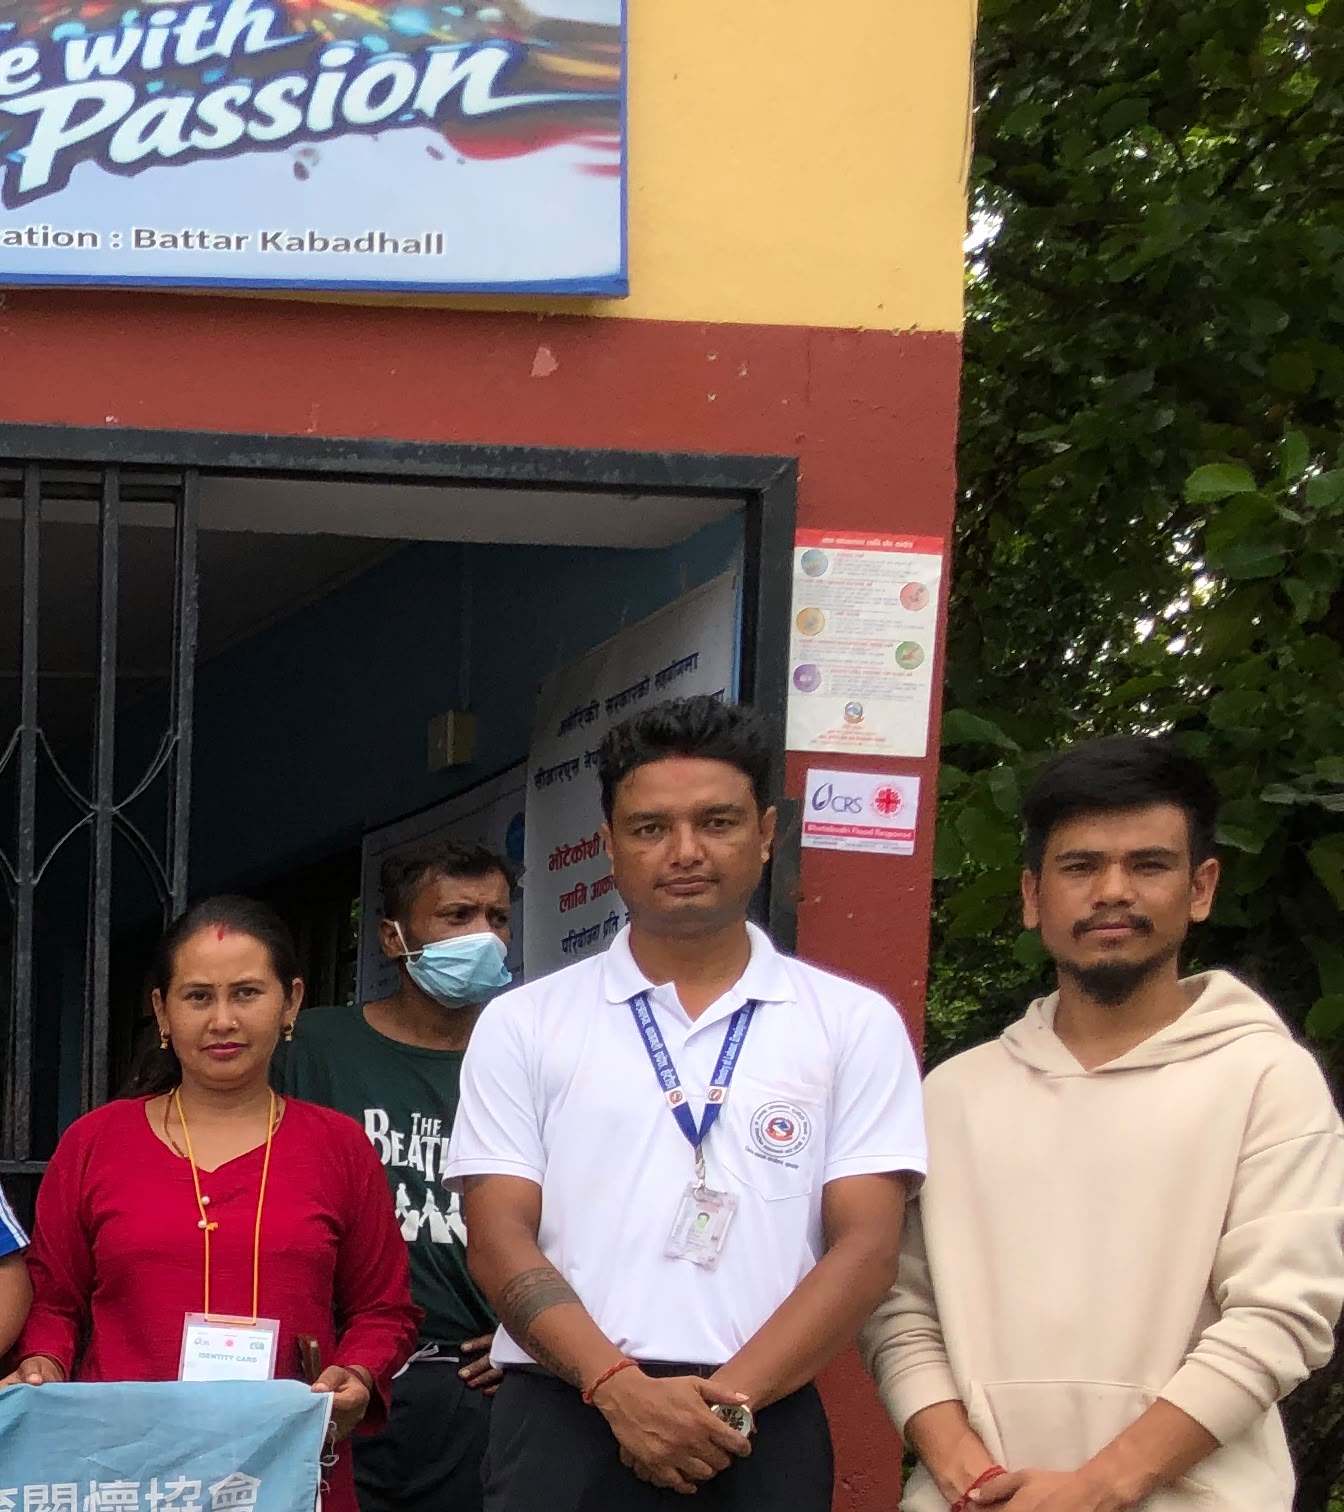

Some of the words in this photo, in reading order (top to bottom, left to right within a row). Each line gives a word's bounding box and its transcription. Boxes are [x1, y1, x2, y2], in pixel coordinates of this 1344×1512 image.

[62, 0, 313, 84] with
[132, 226, 250, 254] Battar
[260, 230, 446, 257] Kabadhall
[831, 795, 863, 814] CRS
[410, 1112, 442, 1137] THE
[198, 1352, 235, 1362] IDENTITY
[235, 1354, 258, 1364] CARD
